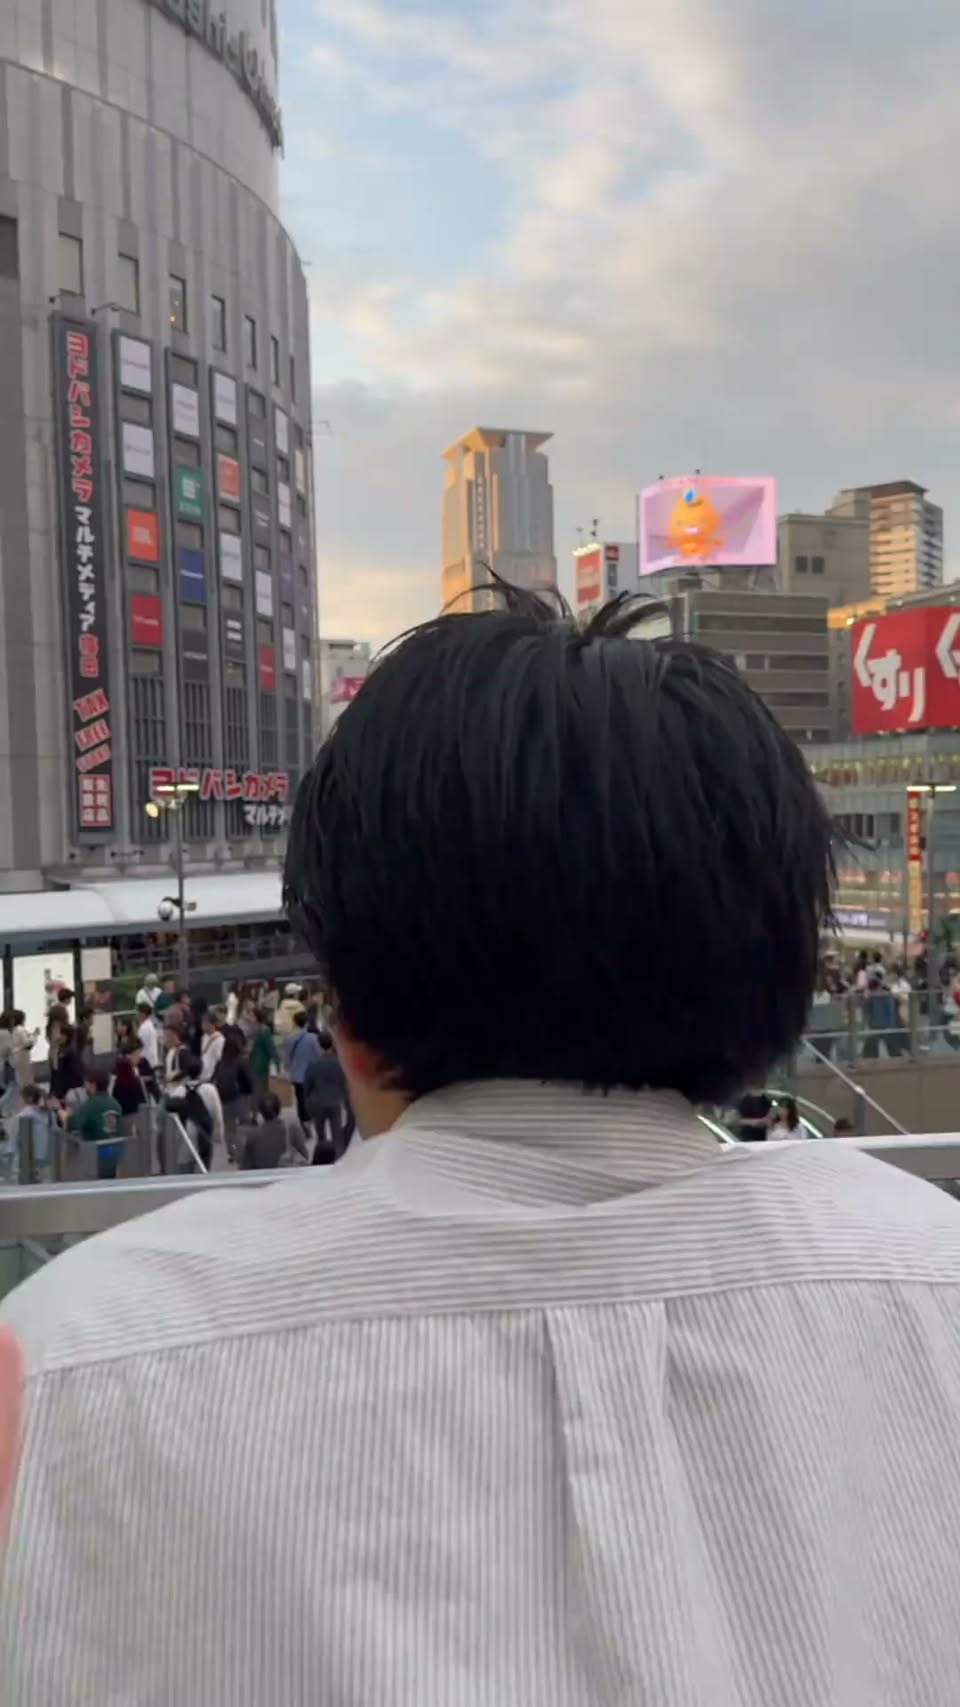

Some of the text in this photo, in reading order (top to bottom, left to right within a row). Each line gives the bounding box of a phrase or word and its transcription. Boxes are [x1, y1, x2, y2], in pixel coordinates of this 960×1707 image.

[67, 331, 93, 501] ヨドバシカメラ
[78, 633, 100, 678] 田
[853, 623, 925, 722] くすり
[935, 612, 960, 690] く
